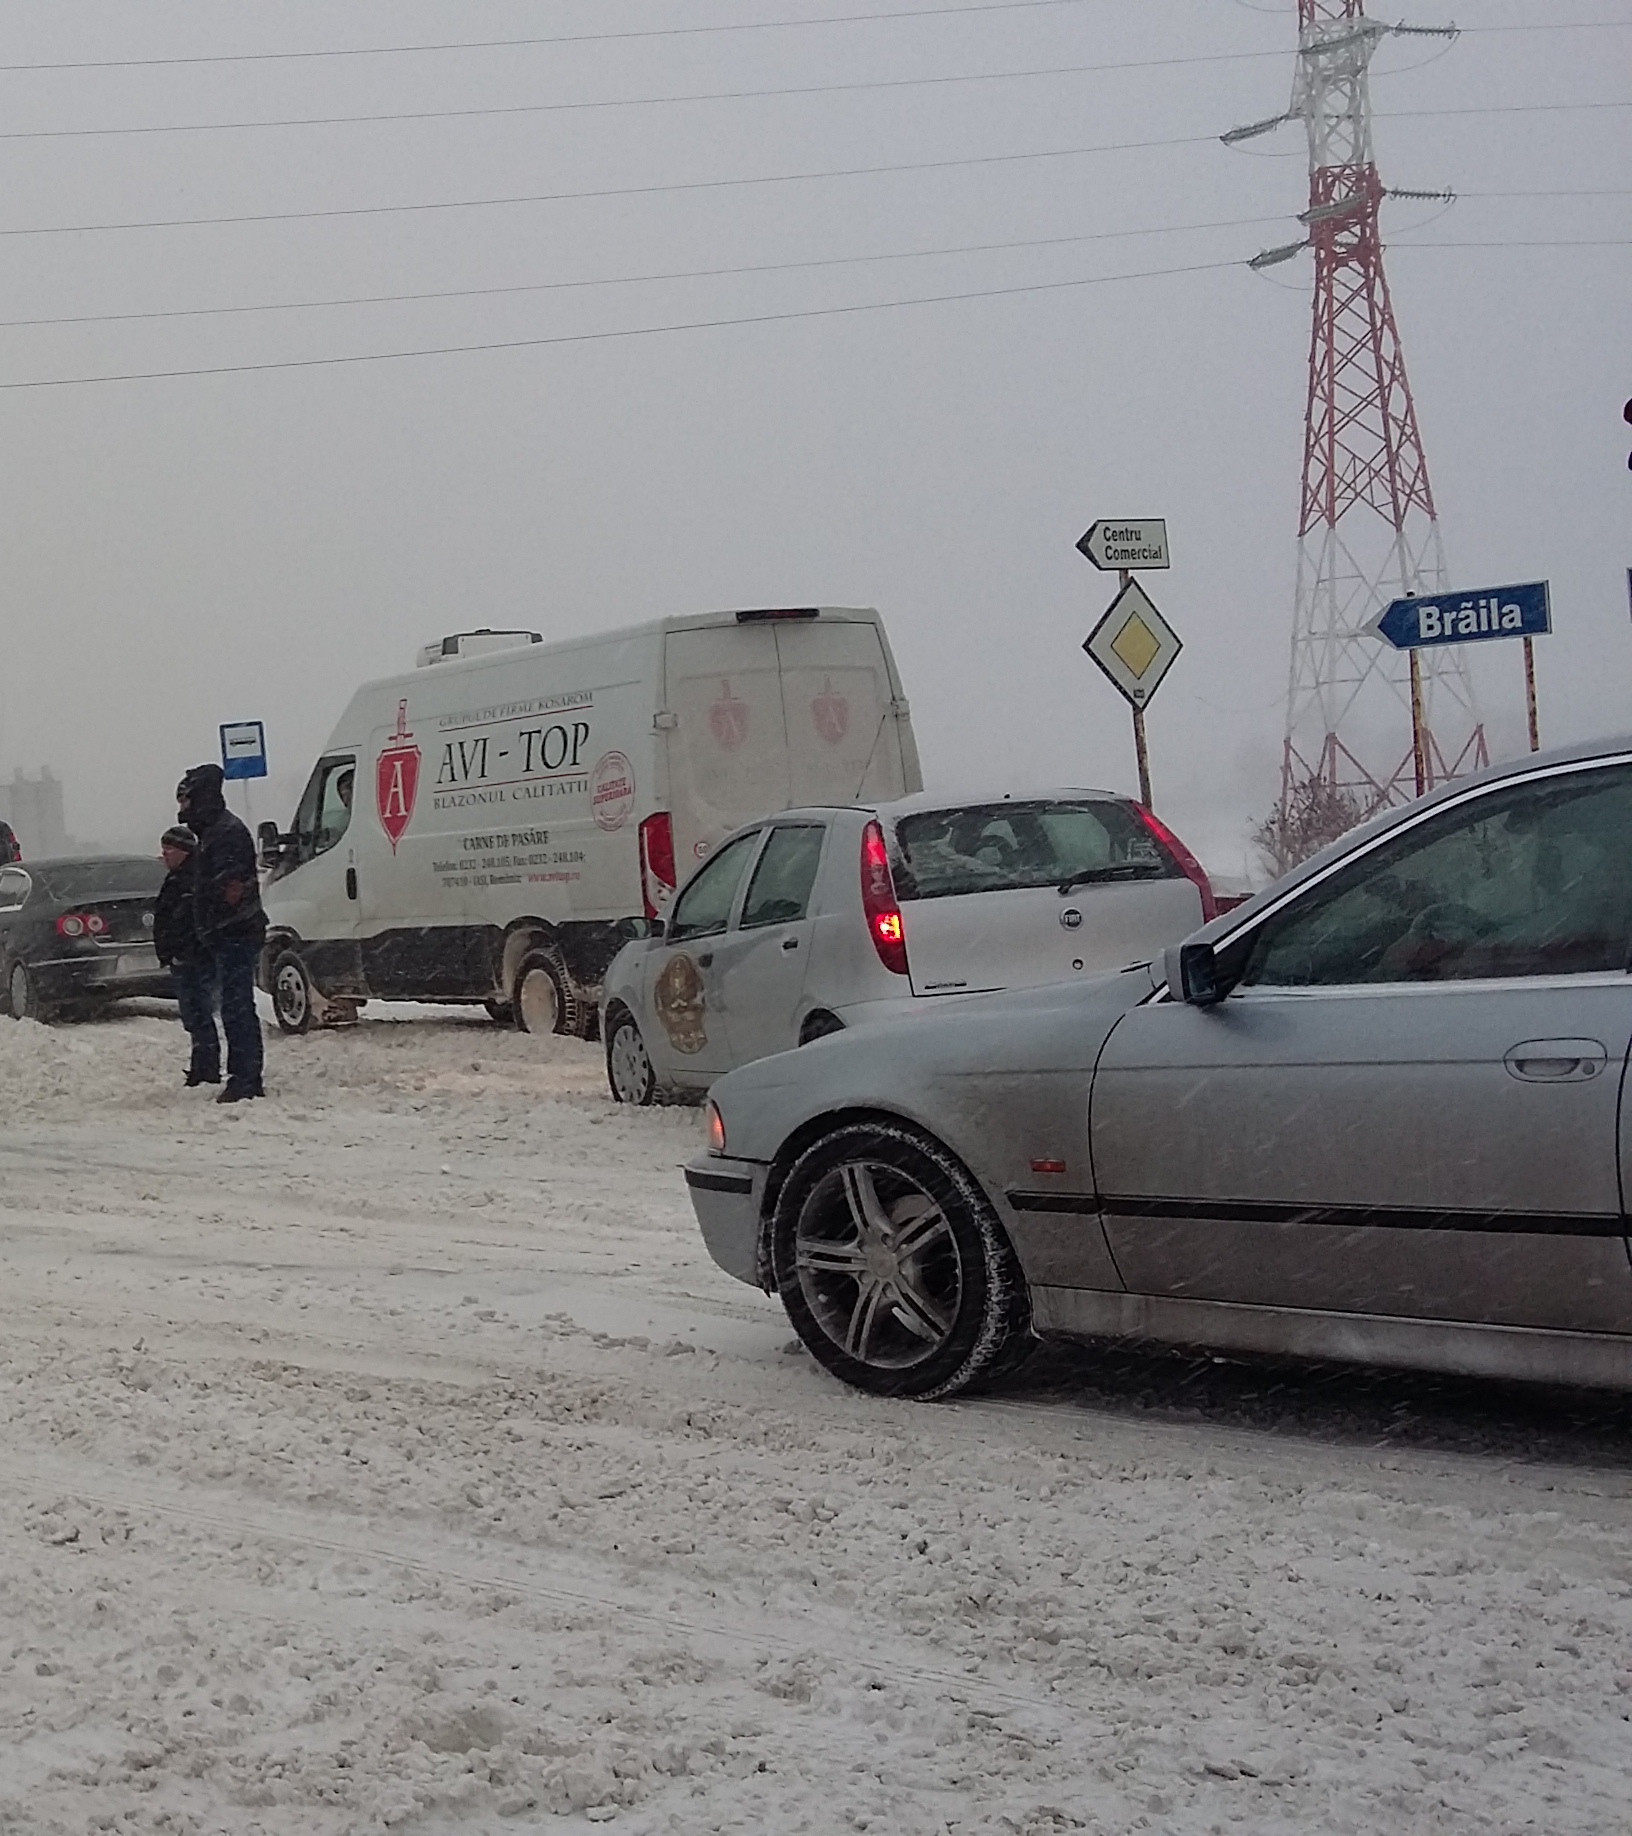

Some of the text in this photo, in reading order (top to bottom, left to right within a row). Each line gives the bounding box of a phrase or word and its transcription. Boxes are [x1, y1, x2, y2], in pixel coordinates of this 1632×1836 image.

[1103, 526, 1142, 542] Centru
[1105, 543, 1163, 561] Comercial
[436, 736, 490, 784] AVI
[519, 722, 589, 773] TOP
[382, 760, 408, 818] A
[434, 790, 506, 810] BLAZONUL
[463, 835, 495, 851] CARNE
[496, 835, 509, 848] DE
